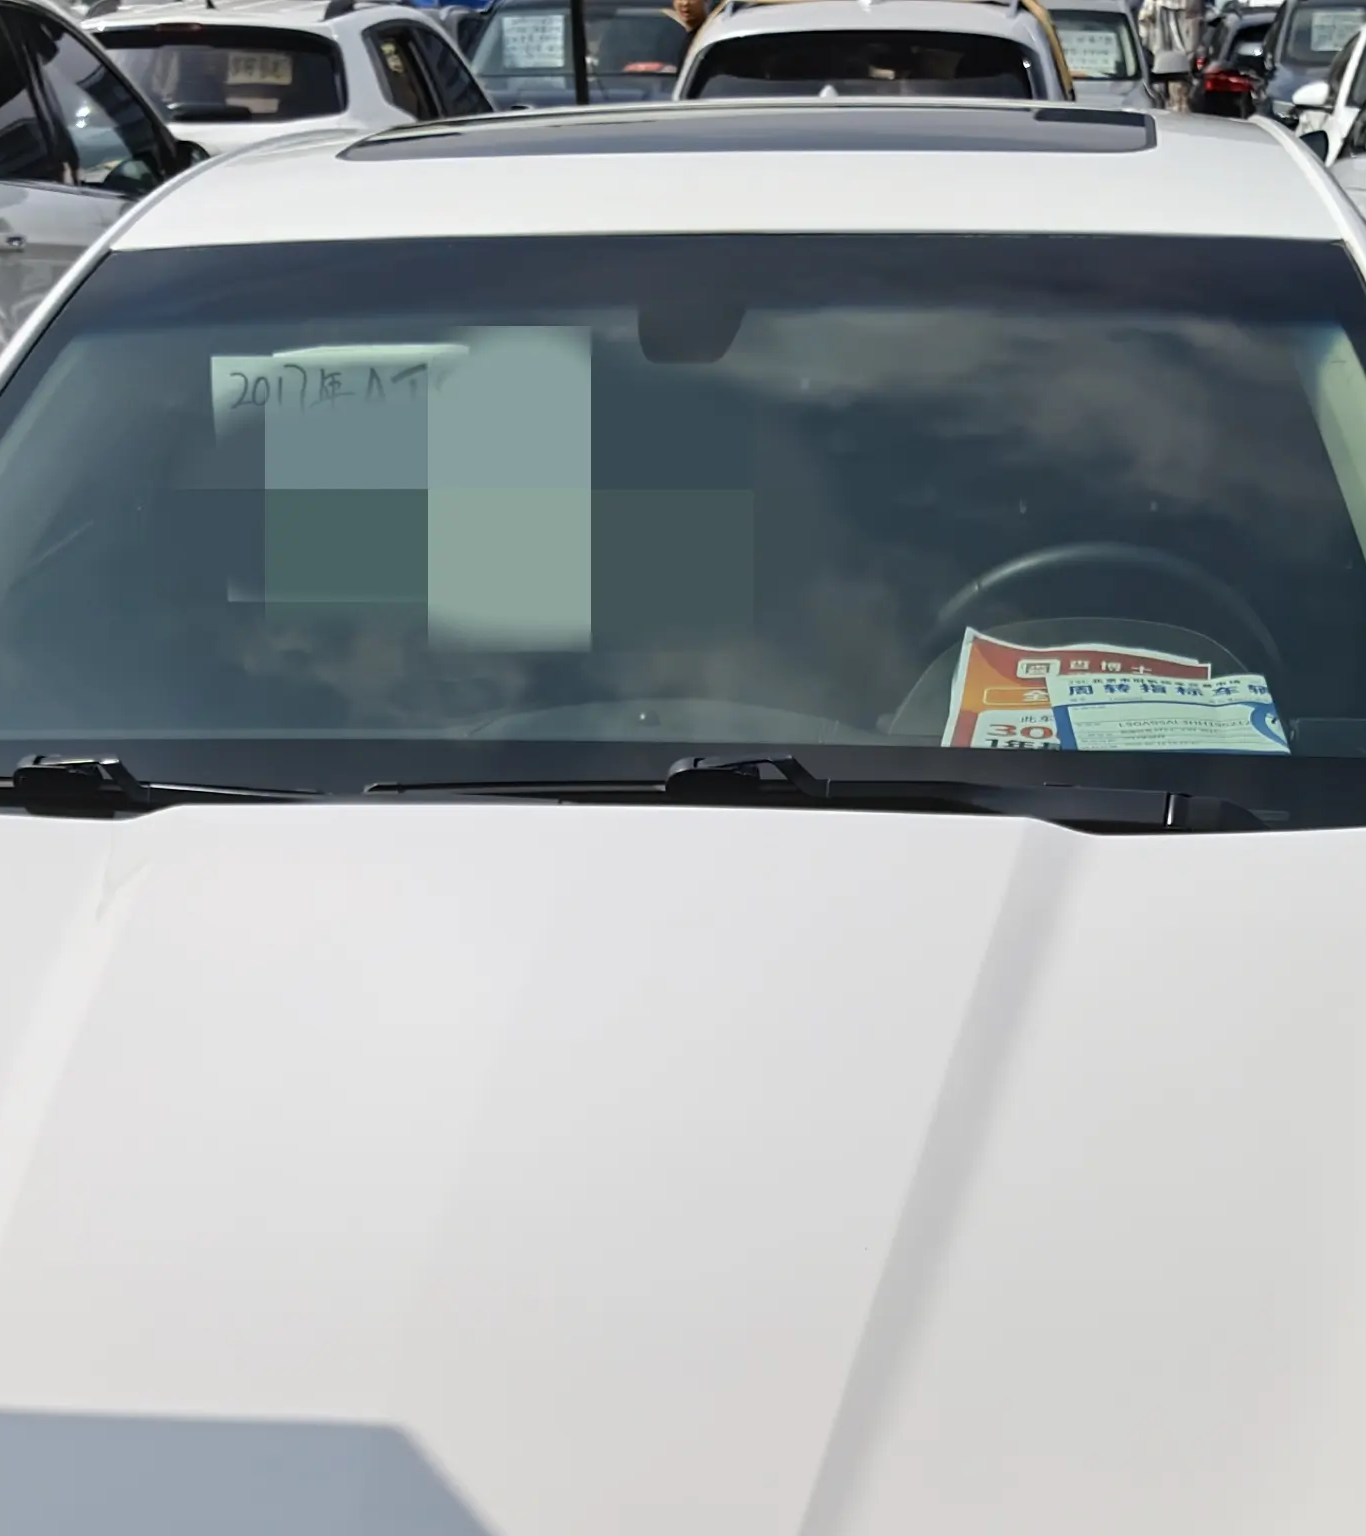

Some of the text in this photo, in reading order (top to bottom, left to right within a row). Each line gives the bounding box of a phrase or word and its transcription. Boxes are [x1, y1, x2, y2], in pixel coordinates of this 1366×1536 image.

[1069, 683, 1269, 697] 周转指标车辆
